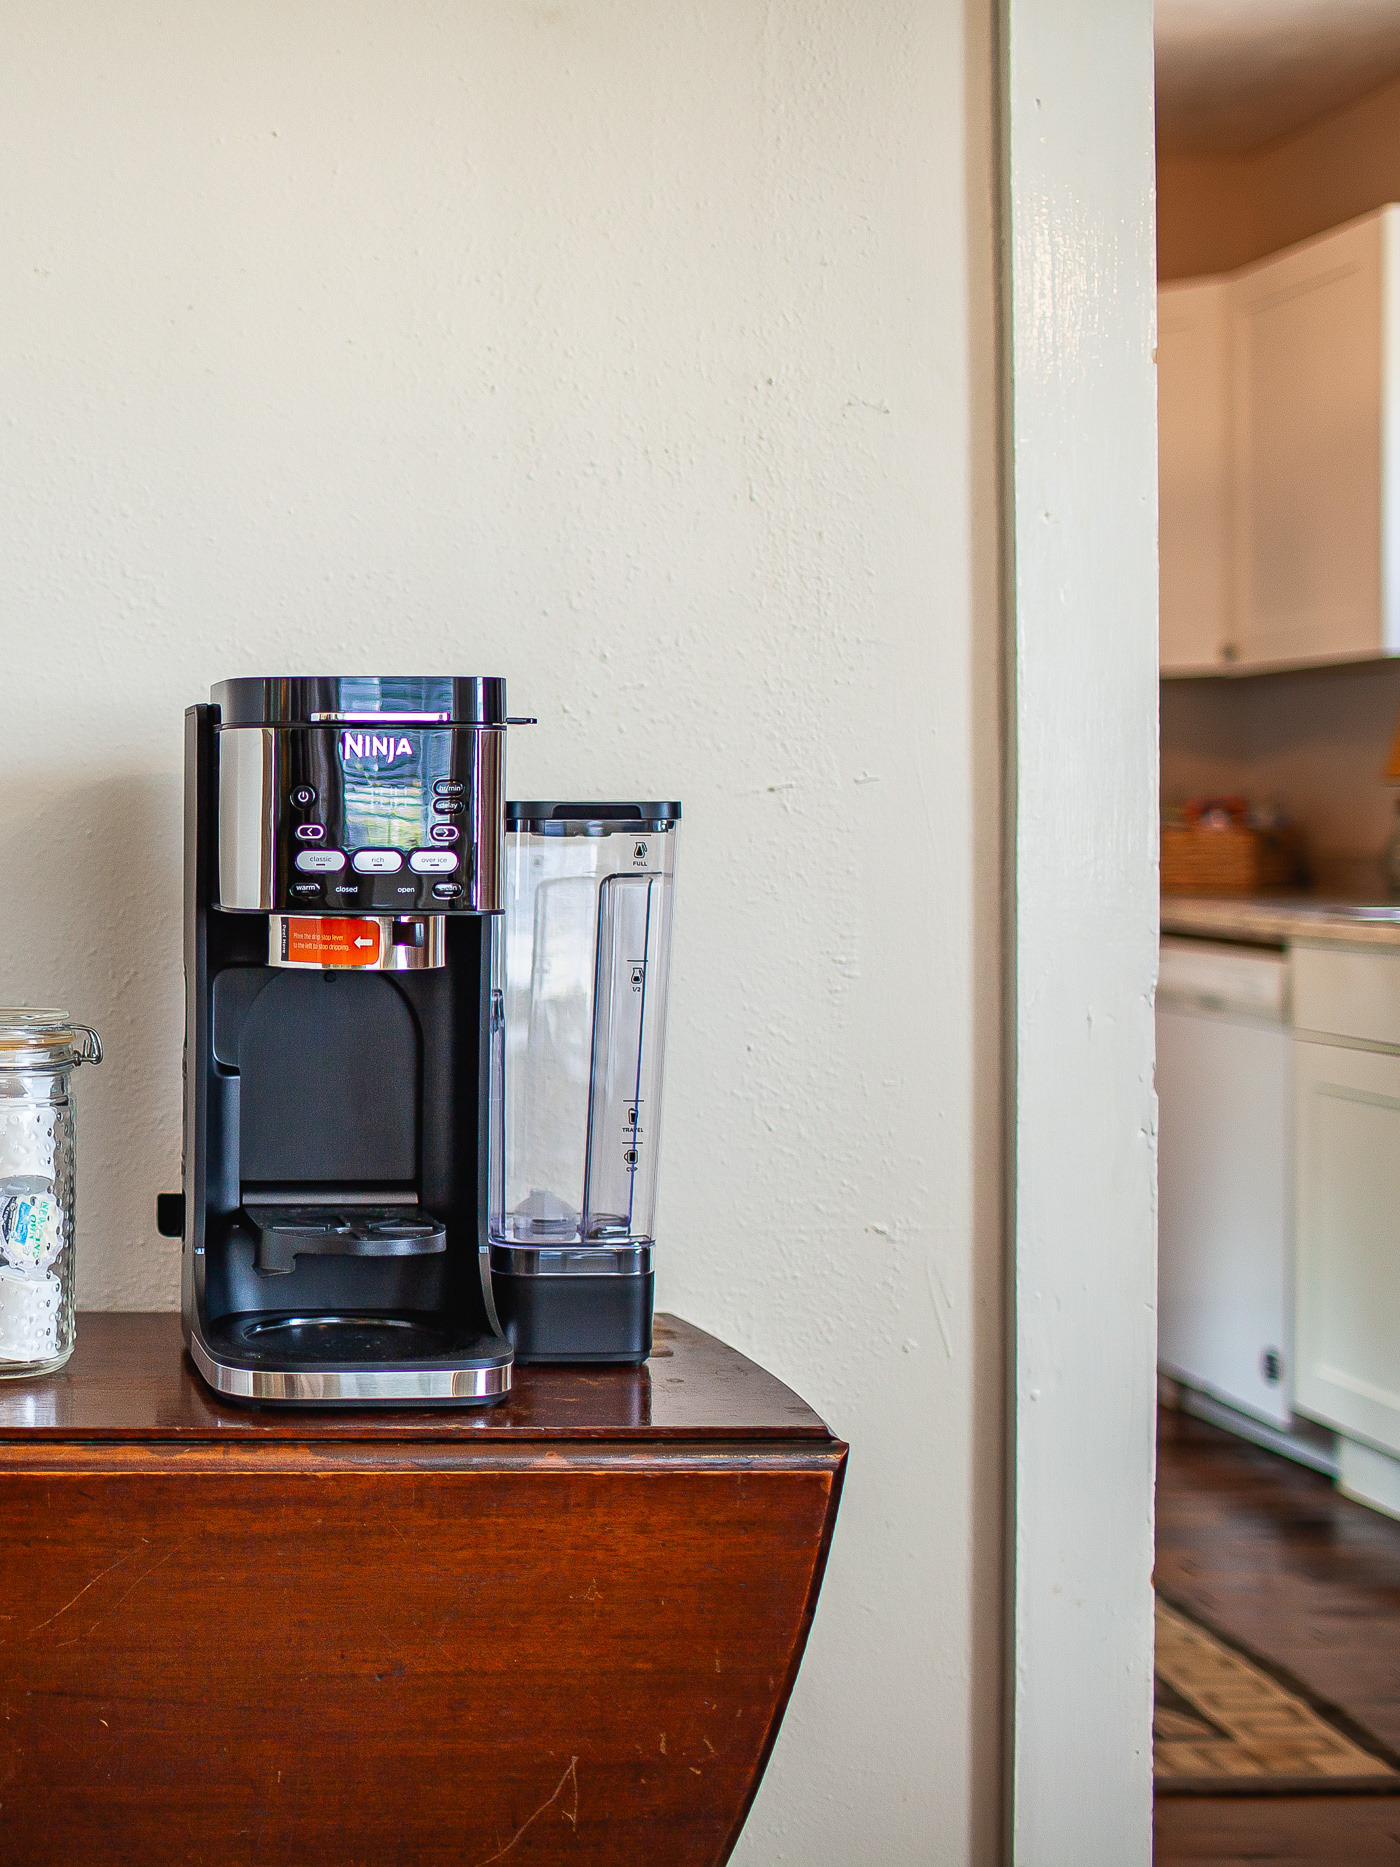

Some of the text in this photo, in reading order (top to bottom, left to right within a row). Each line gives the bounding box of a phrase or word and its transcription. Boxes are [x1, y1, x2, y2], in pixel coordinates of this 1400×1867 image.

[343, 732, 413, 764] NINJA
[439, 784, 461, 792] hr/min
[32, 1201, 50, 1259] NEWN'S
